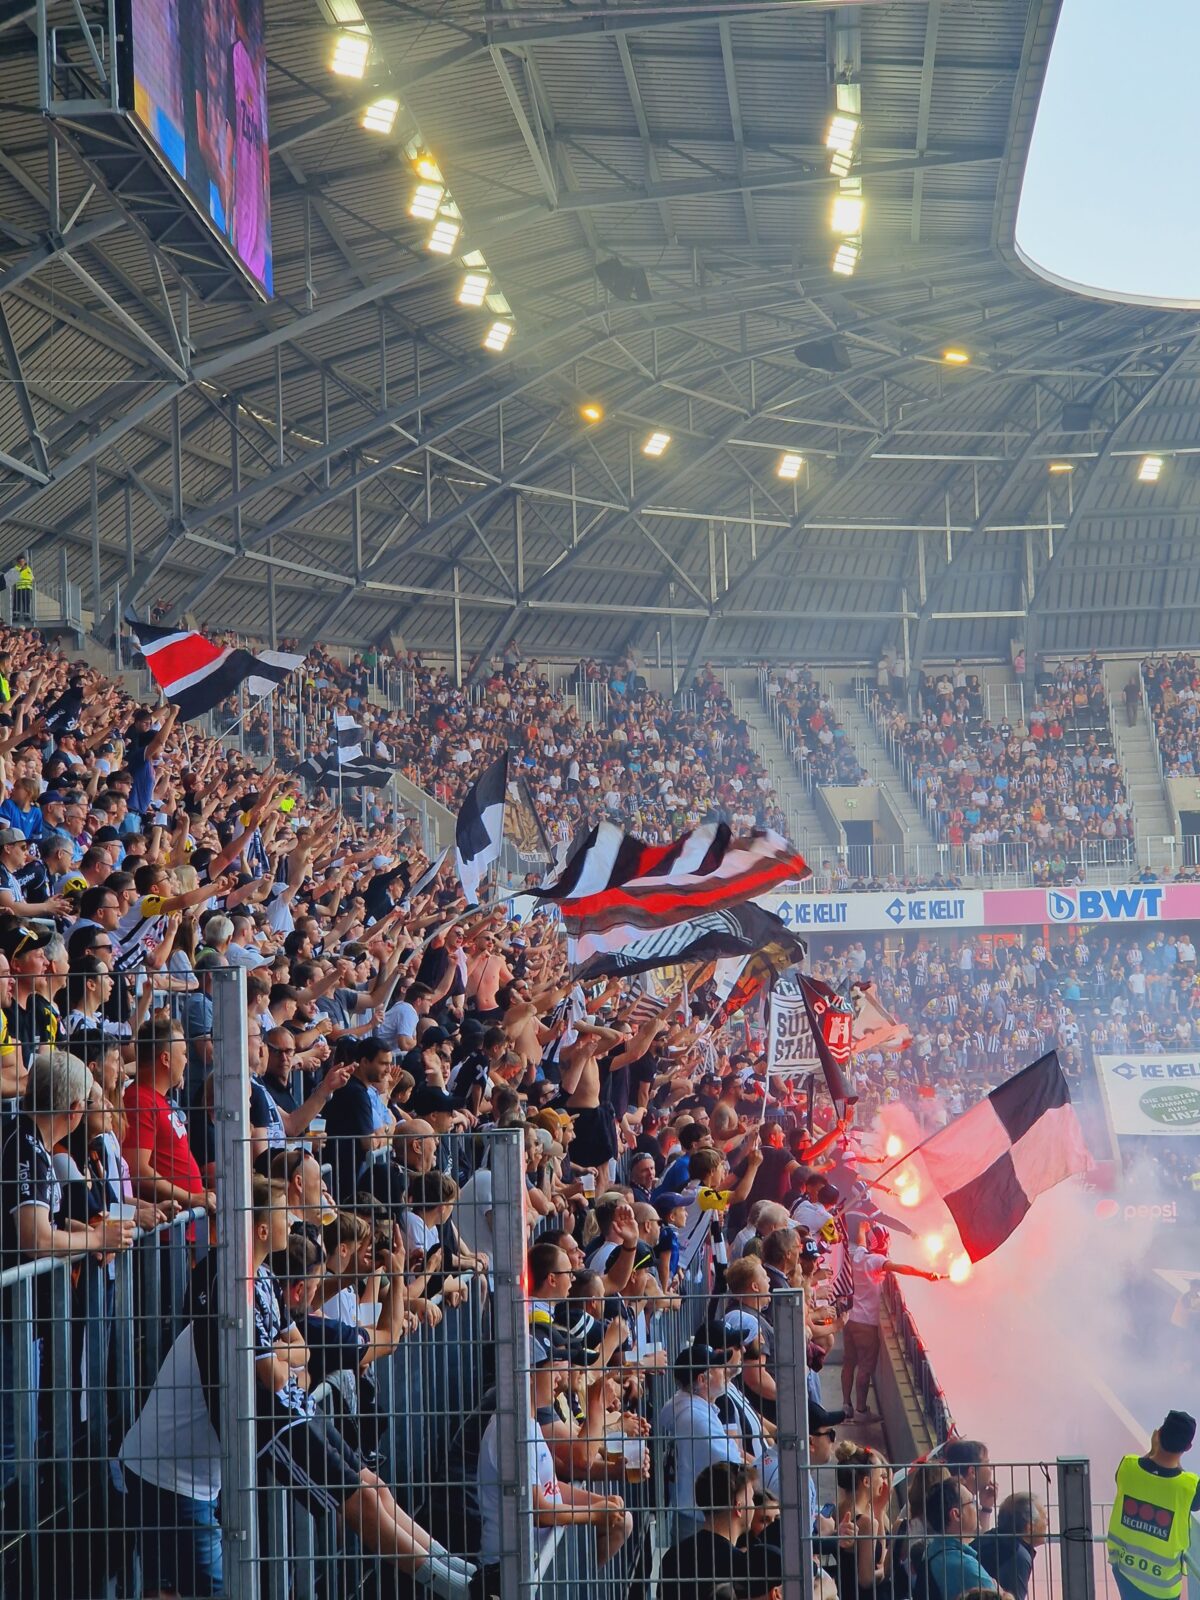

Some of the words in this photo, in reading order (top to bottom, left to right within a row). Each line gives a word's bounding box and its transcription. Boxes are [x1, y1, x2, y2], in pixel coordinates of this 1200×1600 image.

[908, 900, 926, 920] KE
[929, 899, 965, 919] KELIT
[1079, 888, 1162, 919] BWT
[795, 903, 811, 923] KE
[813, 903, 848, 923] KELIT
[1140, 1064, 1165, 1078] KE
[1166, 1063, 1200, 1078] KEL
[1151, 1098, 1195, 1109] KOMMEN
[1160, 1092, 1198, 1101] BESTEN
[1162, 1109, 1200, 1121] LINZ
[1168, 1105, 1187, 1113] AUS
[1124, 1201, 1177, 1221] pepsi
[1122, 1514, 1168, 1538] SECURITAS
